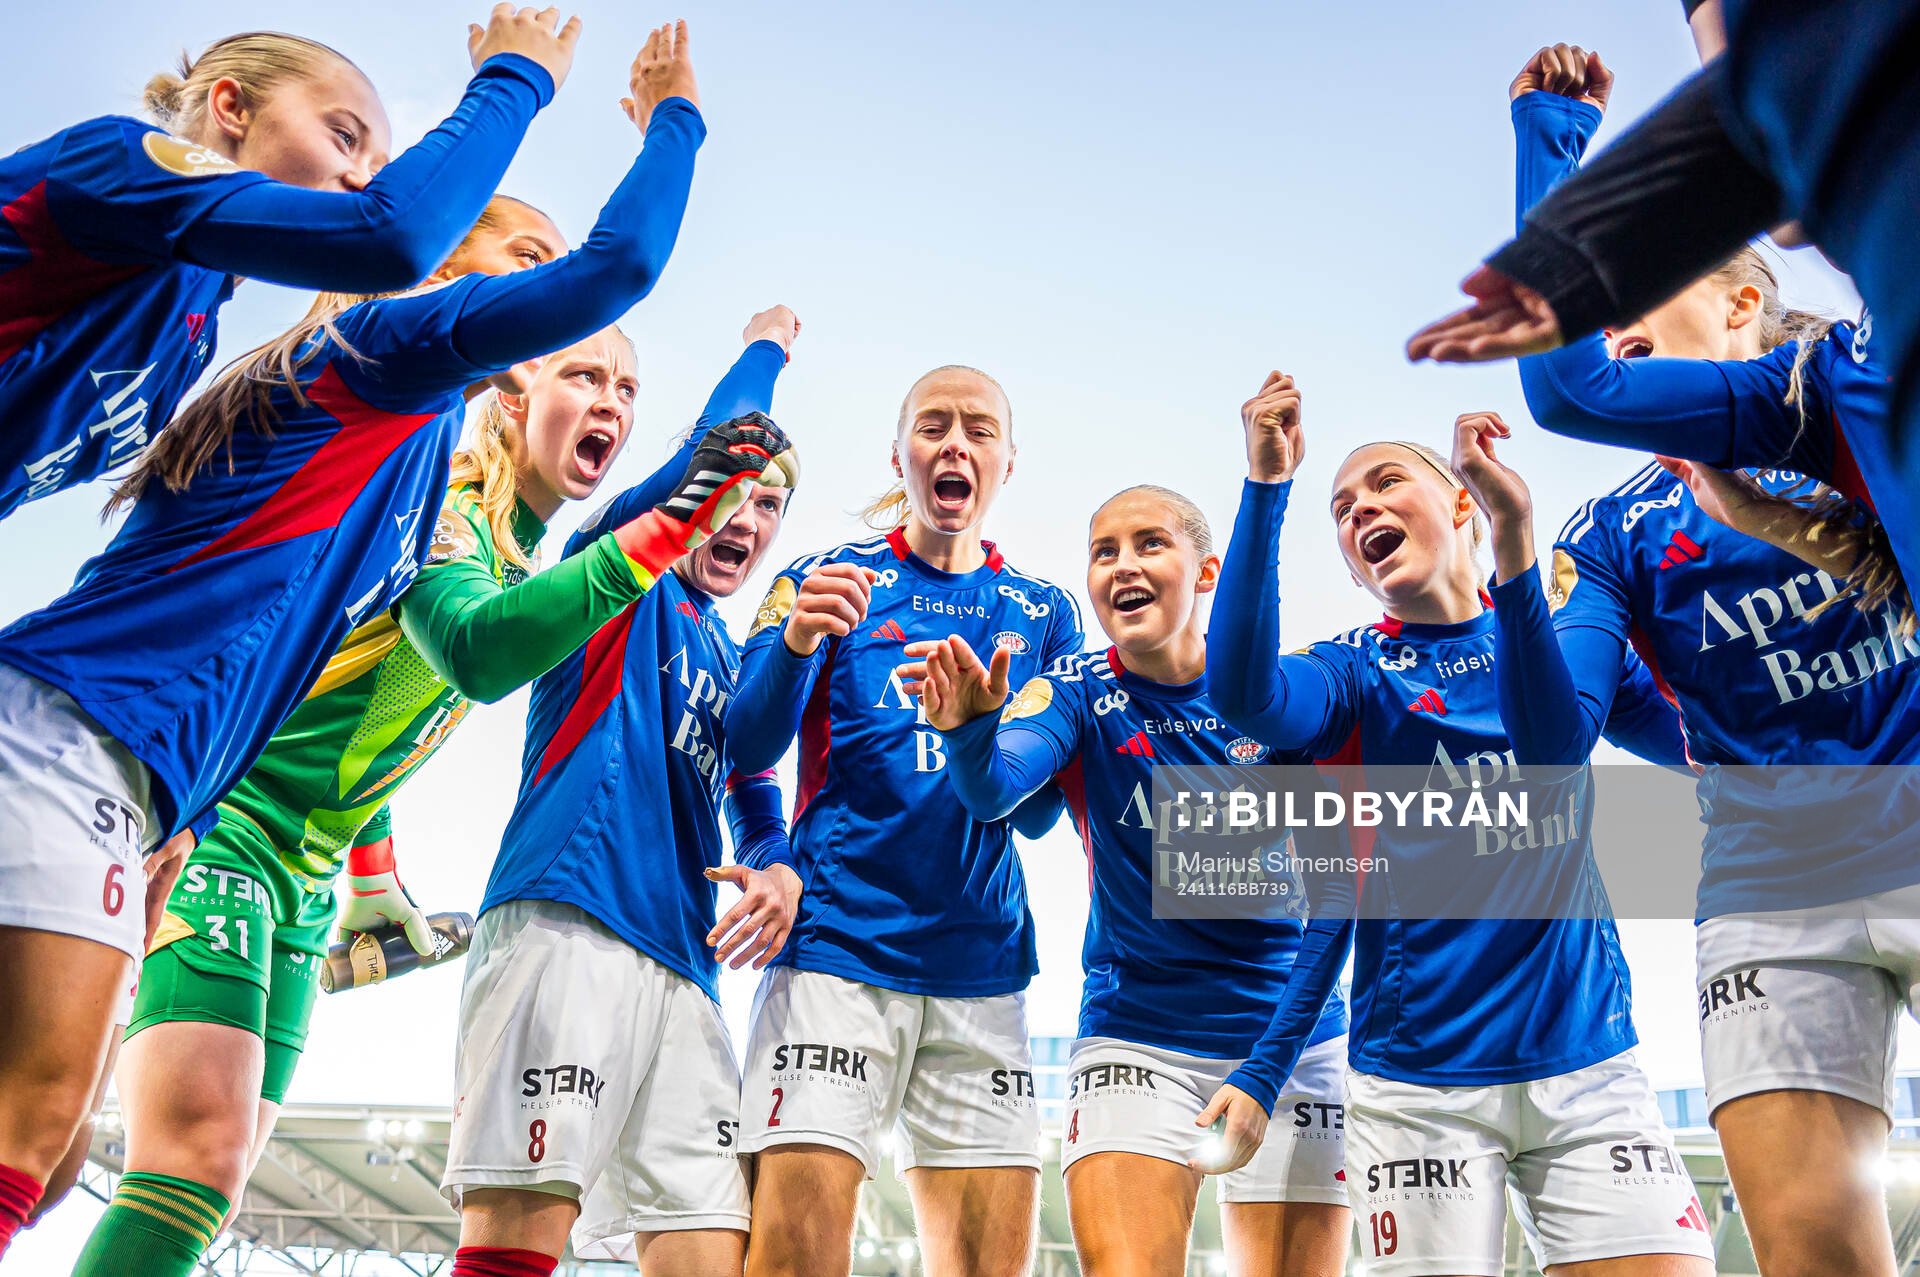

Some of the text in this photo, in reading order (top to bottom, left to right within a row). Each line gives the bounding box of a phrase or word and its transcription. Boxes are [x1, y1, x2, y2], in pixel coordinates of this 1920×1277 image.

[998, 585, 1051, 620] coop
[103, 864, 124, 916] 6
[180, 896, 225, 906] HELSE
[205, 915, 249, 959] 31
[1709, 1002, 1769, 1026] TRENING
[772, 1043, 868, 1083] STERK
[771, 1073, 801, 1082] HELSE
[823, 1077, 867, 1094] TRENING
[1107, 1088, 1159, 1100] TRENING
[767, 1087, 784, 1127] 2
[528, 1119, 547, 1164] 8
[1068, 1109, 1080, 1144] 4
[1292, 1131, 1328, 1140] HELSE
[1367, 1158, 1472, 1193] STERK
[1613, 1177, 1657, 1185] HELSE
[1420, 1191, 1475, 1201] TRENING
[1369, 1209, 1399, 1258] 19
